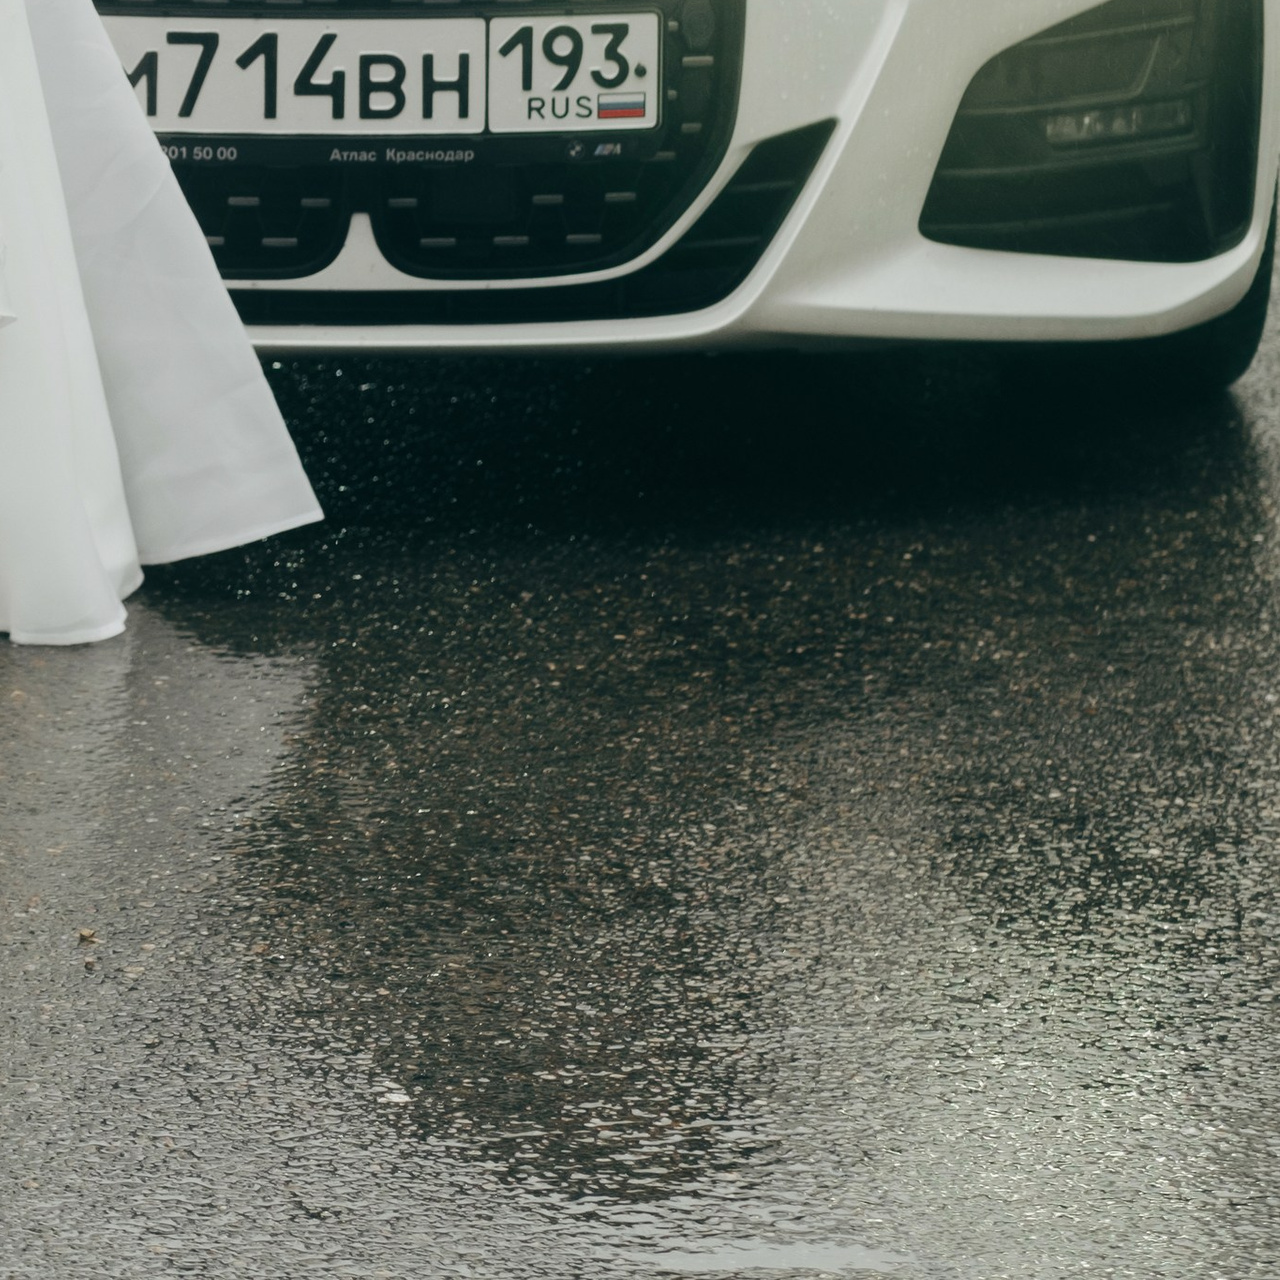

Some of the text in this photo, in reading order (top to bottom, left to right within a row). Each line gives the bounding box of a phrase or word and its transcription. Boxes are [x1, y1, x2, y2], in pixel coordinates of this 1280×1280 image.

[498, 23, 630, 92] 193
[527, 95, 593, 120] RUS
[193, 146, 213, 160] 50
[217, 146, 238, 160] 00
[329, 148, 475, 164] Атлас Краснодар
